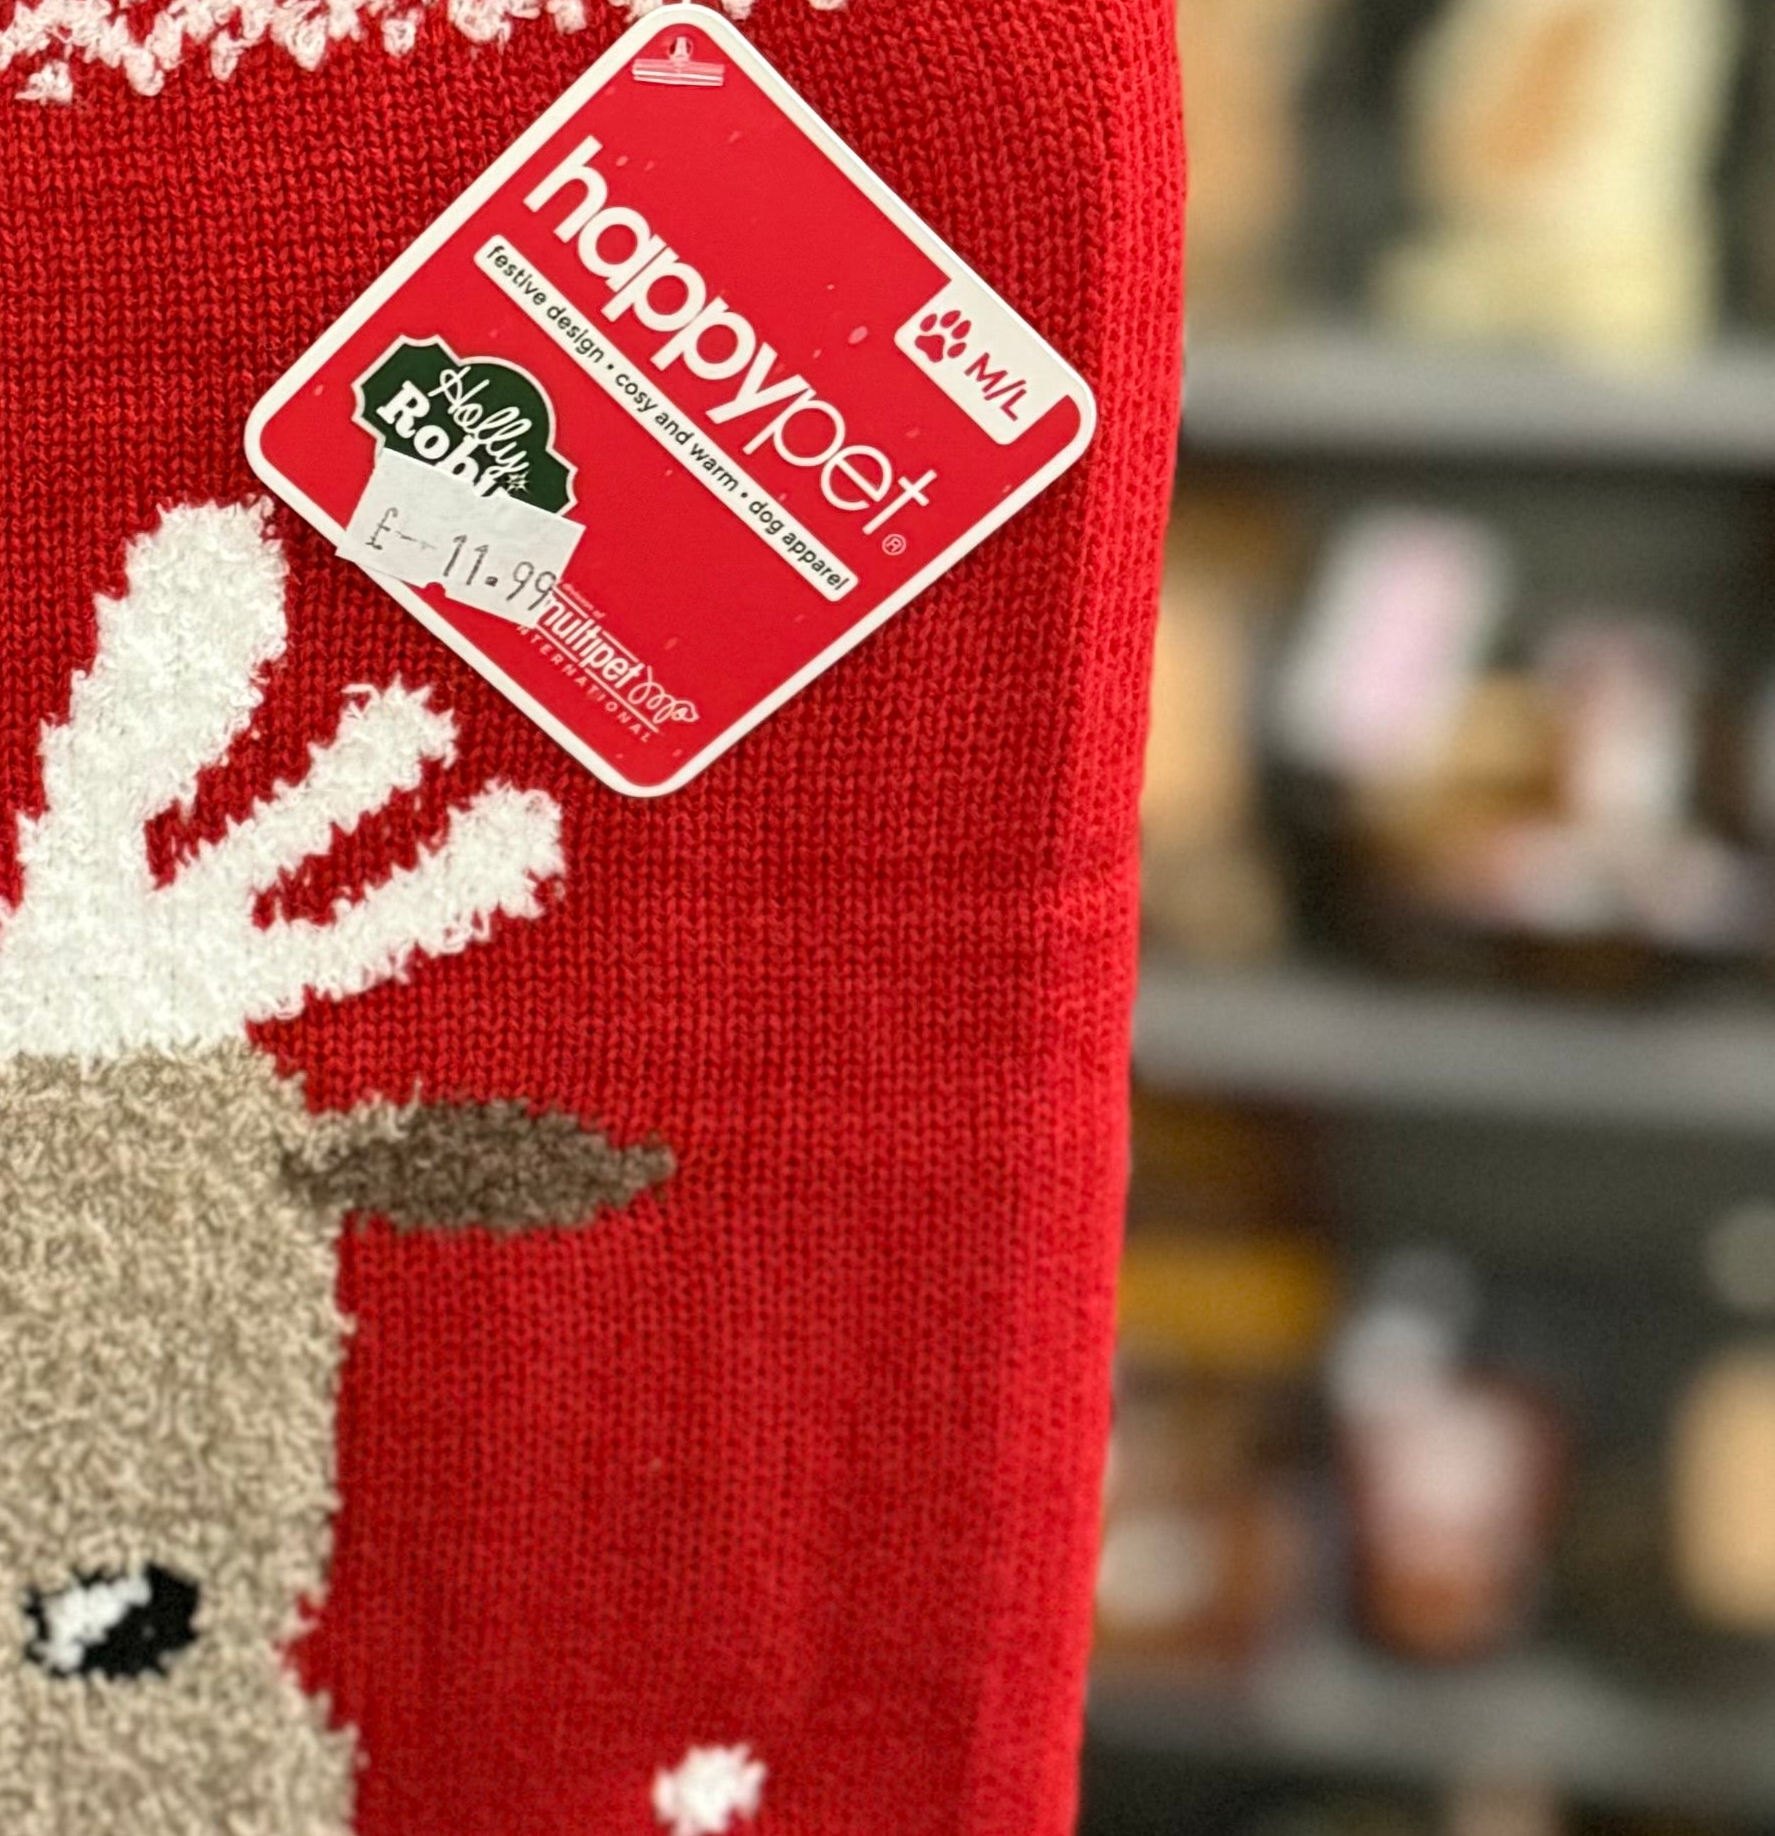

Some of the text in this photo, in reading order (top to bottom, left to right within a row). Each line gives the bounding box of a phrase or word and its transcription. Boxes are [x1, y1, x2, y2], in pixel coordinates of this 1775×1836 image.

[427, 366, 533, 483] Holly
[486, 245, 850, 591] festive design cosy and warm dog apparel
[964, 352, 1027, 422] M/L
[516, 624, 652, 743] NTERNATIONAL
